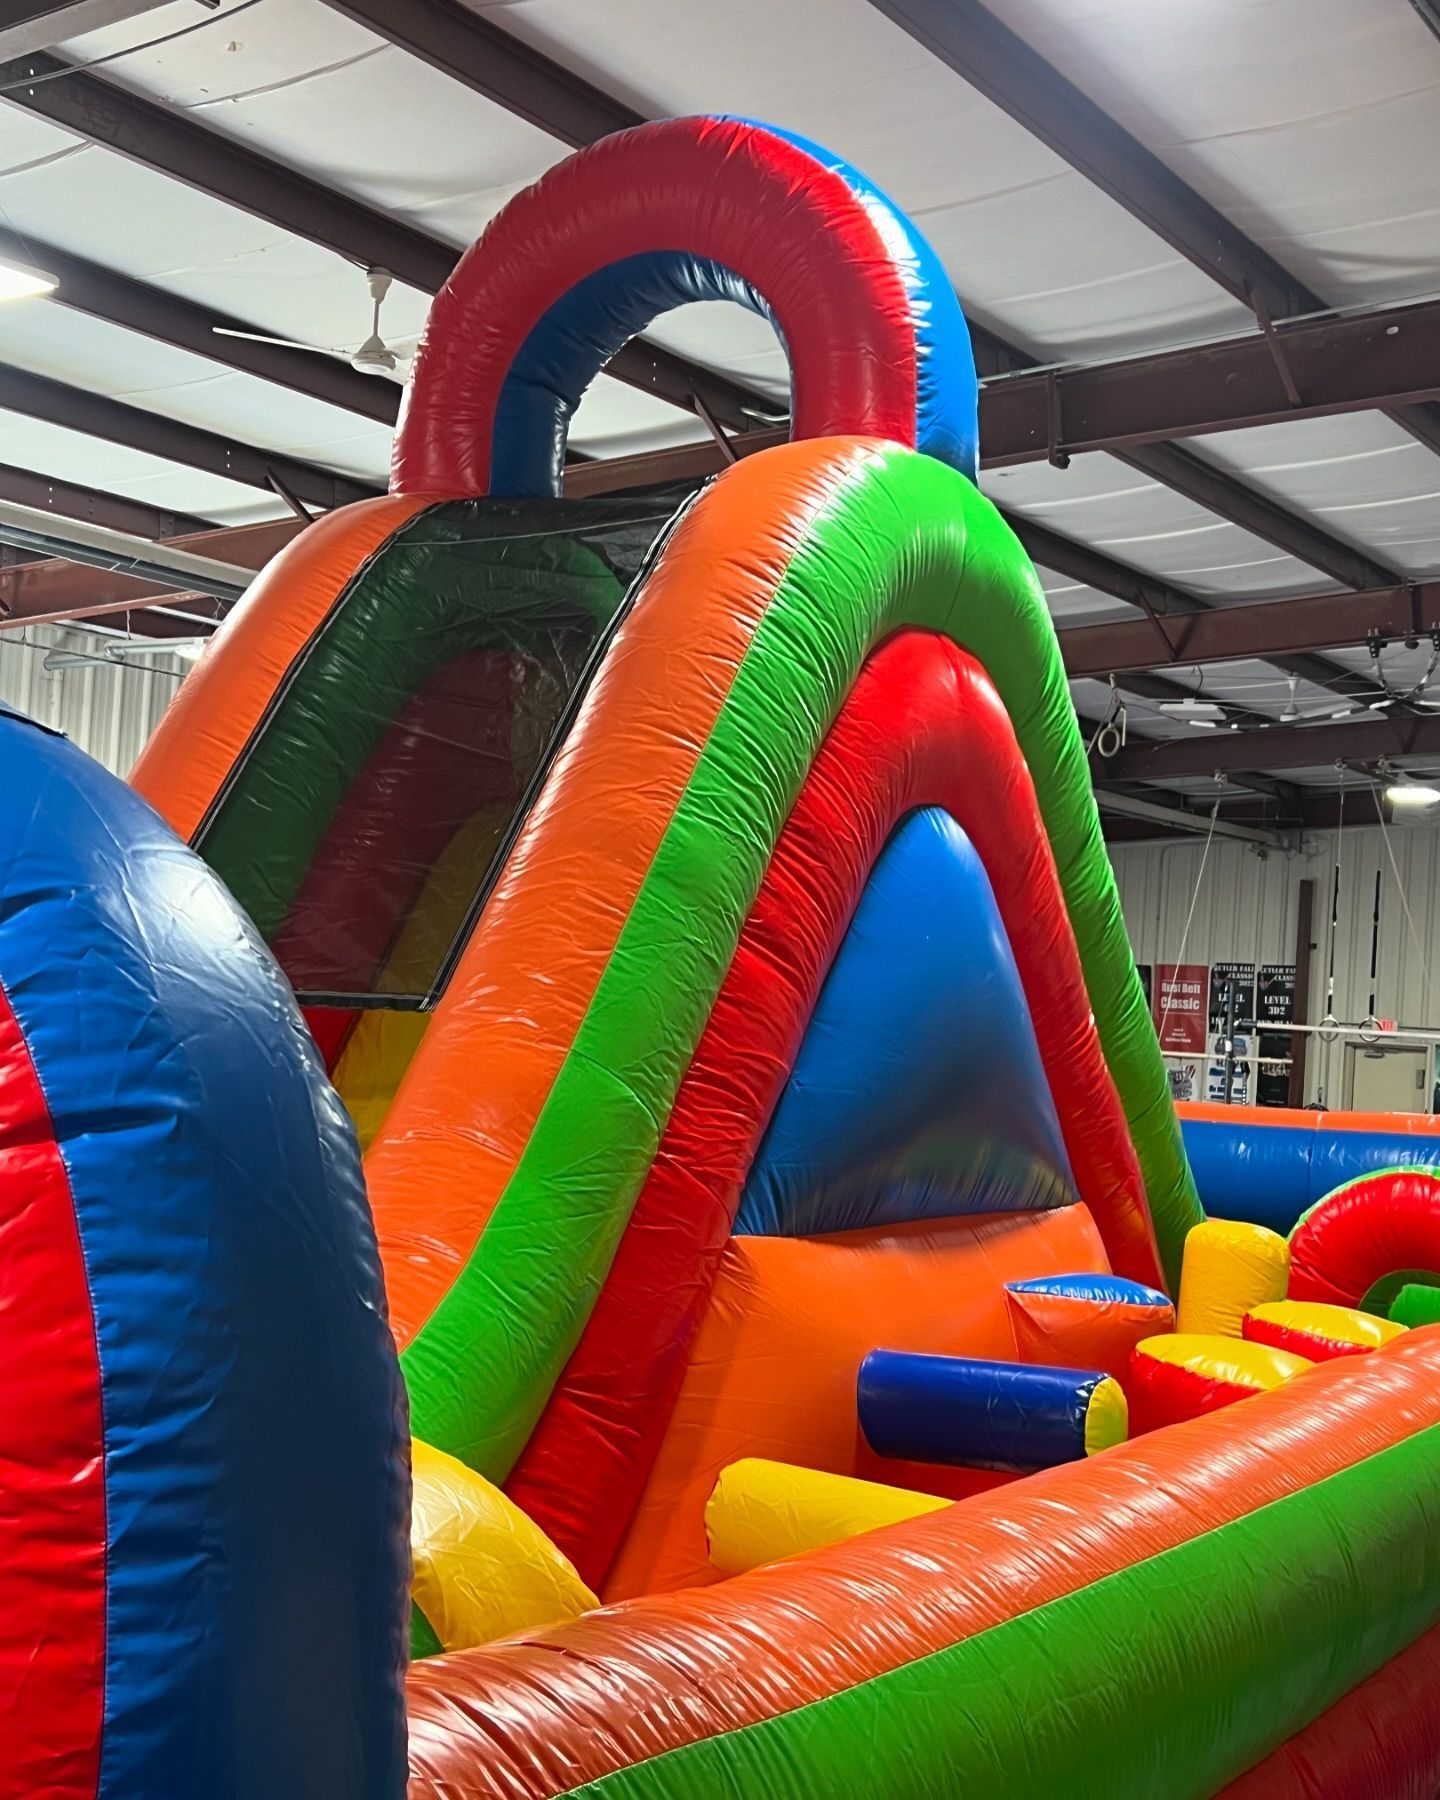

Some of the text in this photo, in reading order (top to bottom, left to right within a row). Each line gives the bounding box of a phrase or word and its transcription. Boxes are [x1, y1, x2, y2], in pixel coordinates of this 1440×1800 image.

[1161, 982, 1201, 994] Rust Belt
[1160, 996, 1200, 1010] Classic
[1218, 992, 1246, 1003] LEEL
[1264, 995, 1291, 1005] LEVEL
